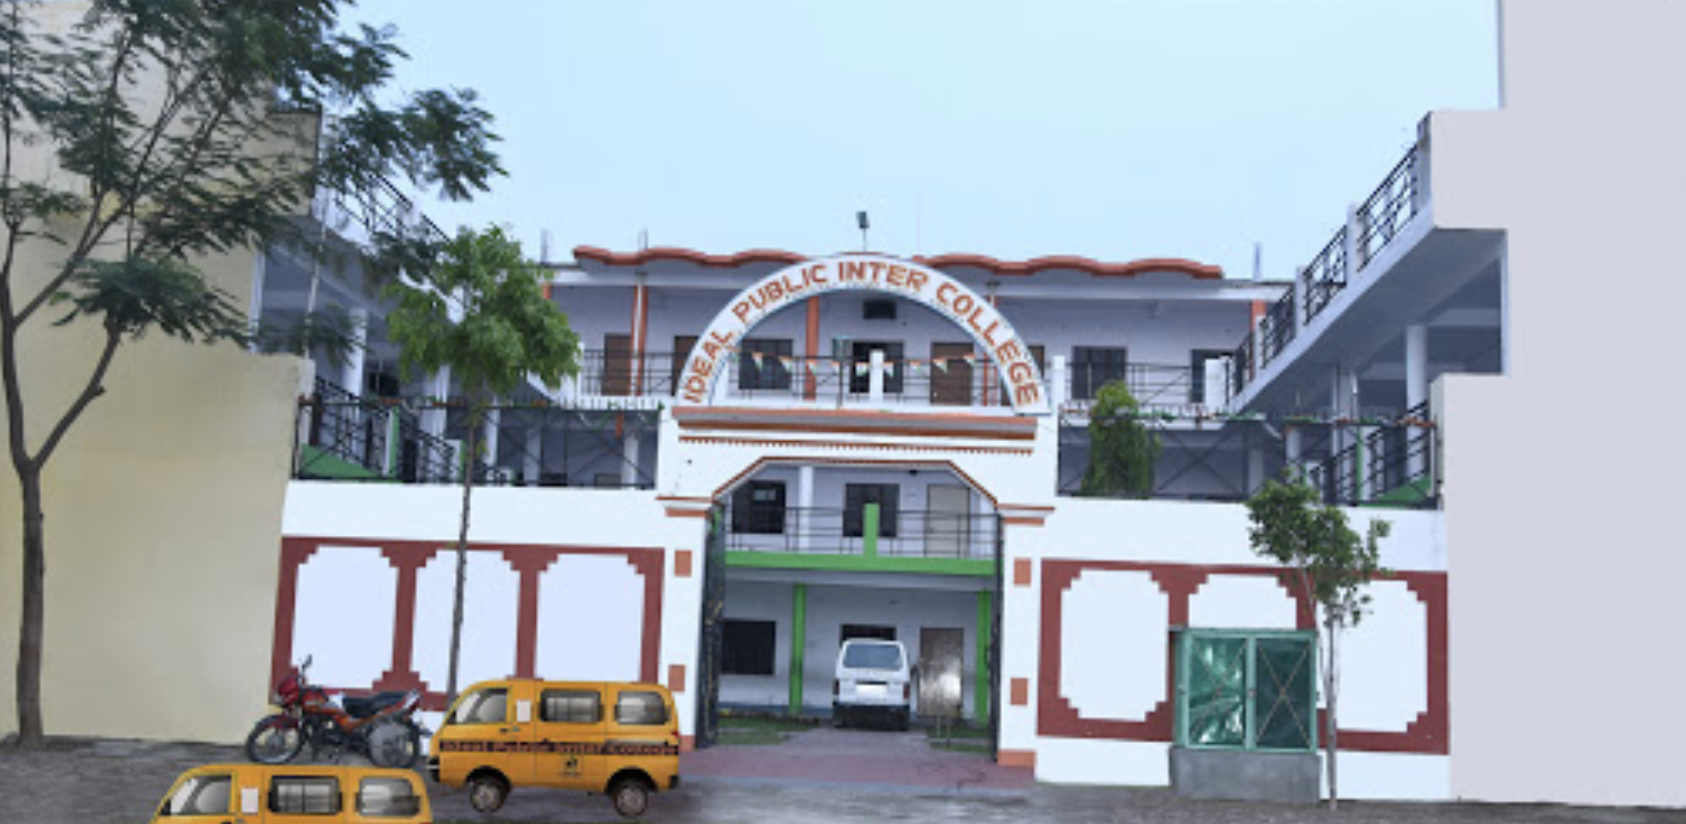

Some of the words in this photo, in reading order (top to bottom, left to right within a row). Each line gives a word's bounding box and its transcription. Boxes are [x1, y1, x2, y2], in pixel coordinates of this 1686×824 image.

[684, 331, 733, 403] IDEAL
[731, 264, 827, 323] PUBLIC
[838, 261, 929, 293] INTER
[936, 282, 1039, 406] COLLEGE
